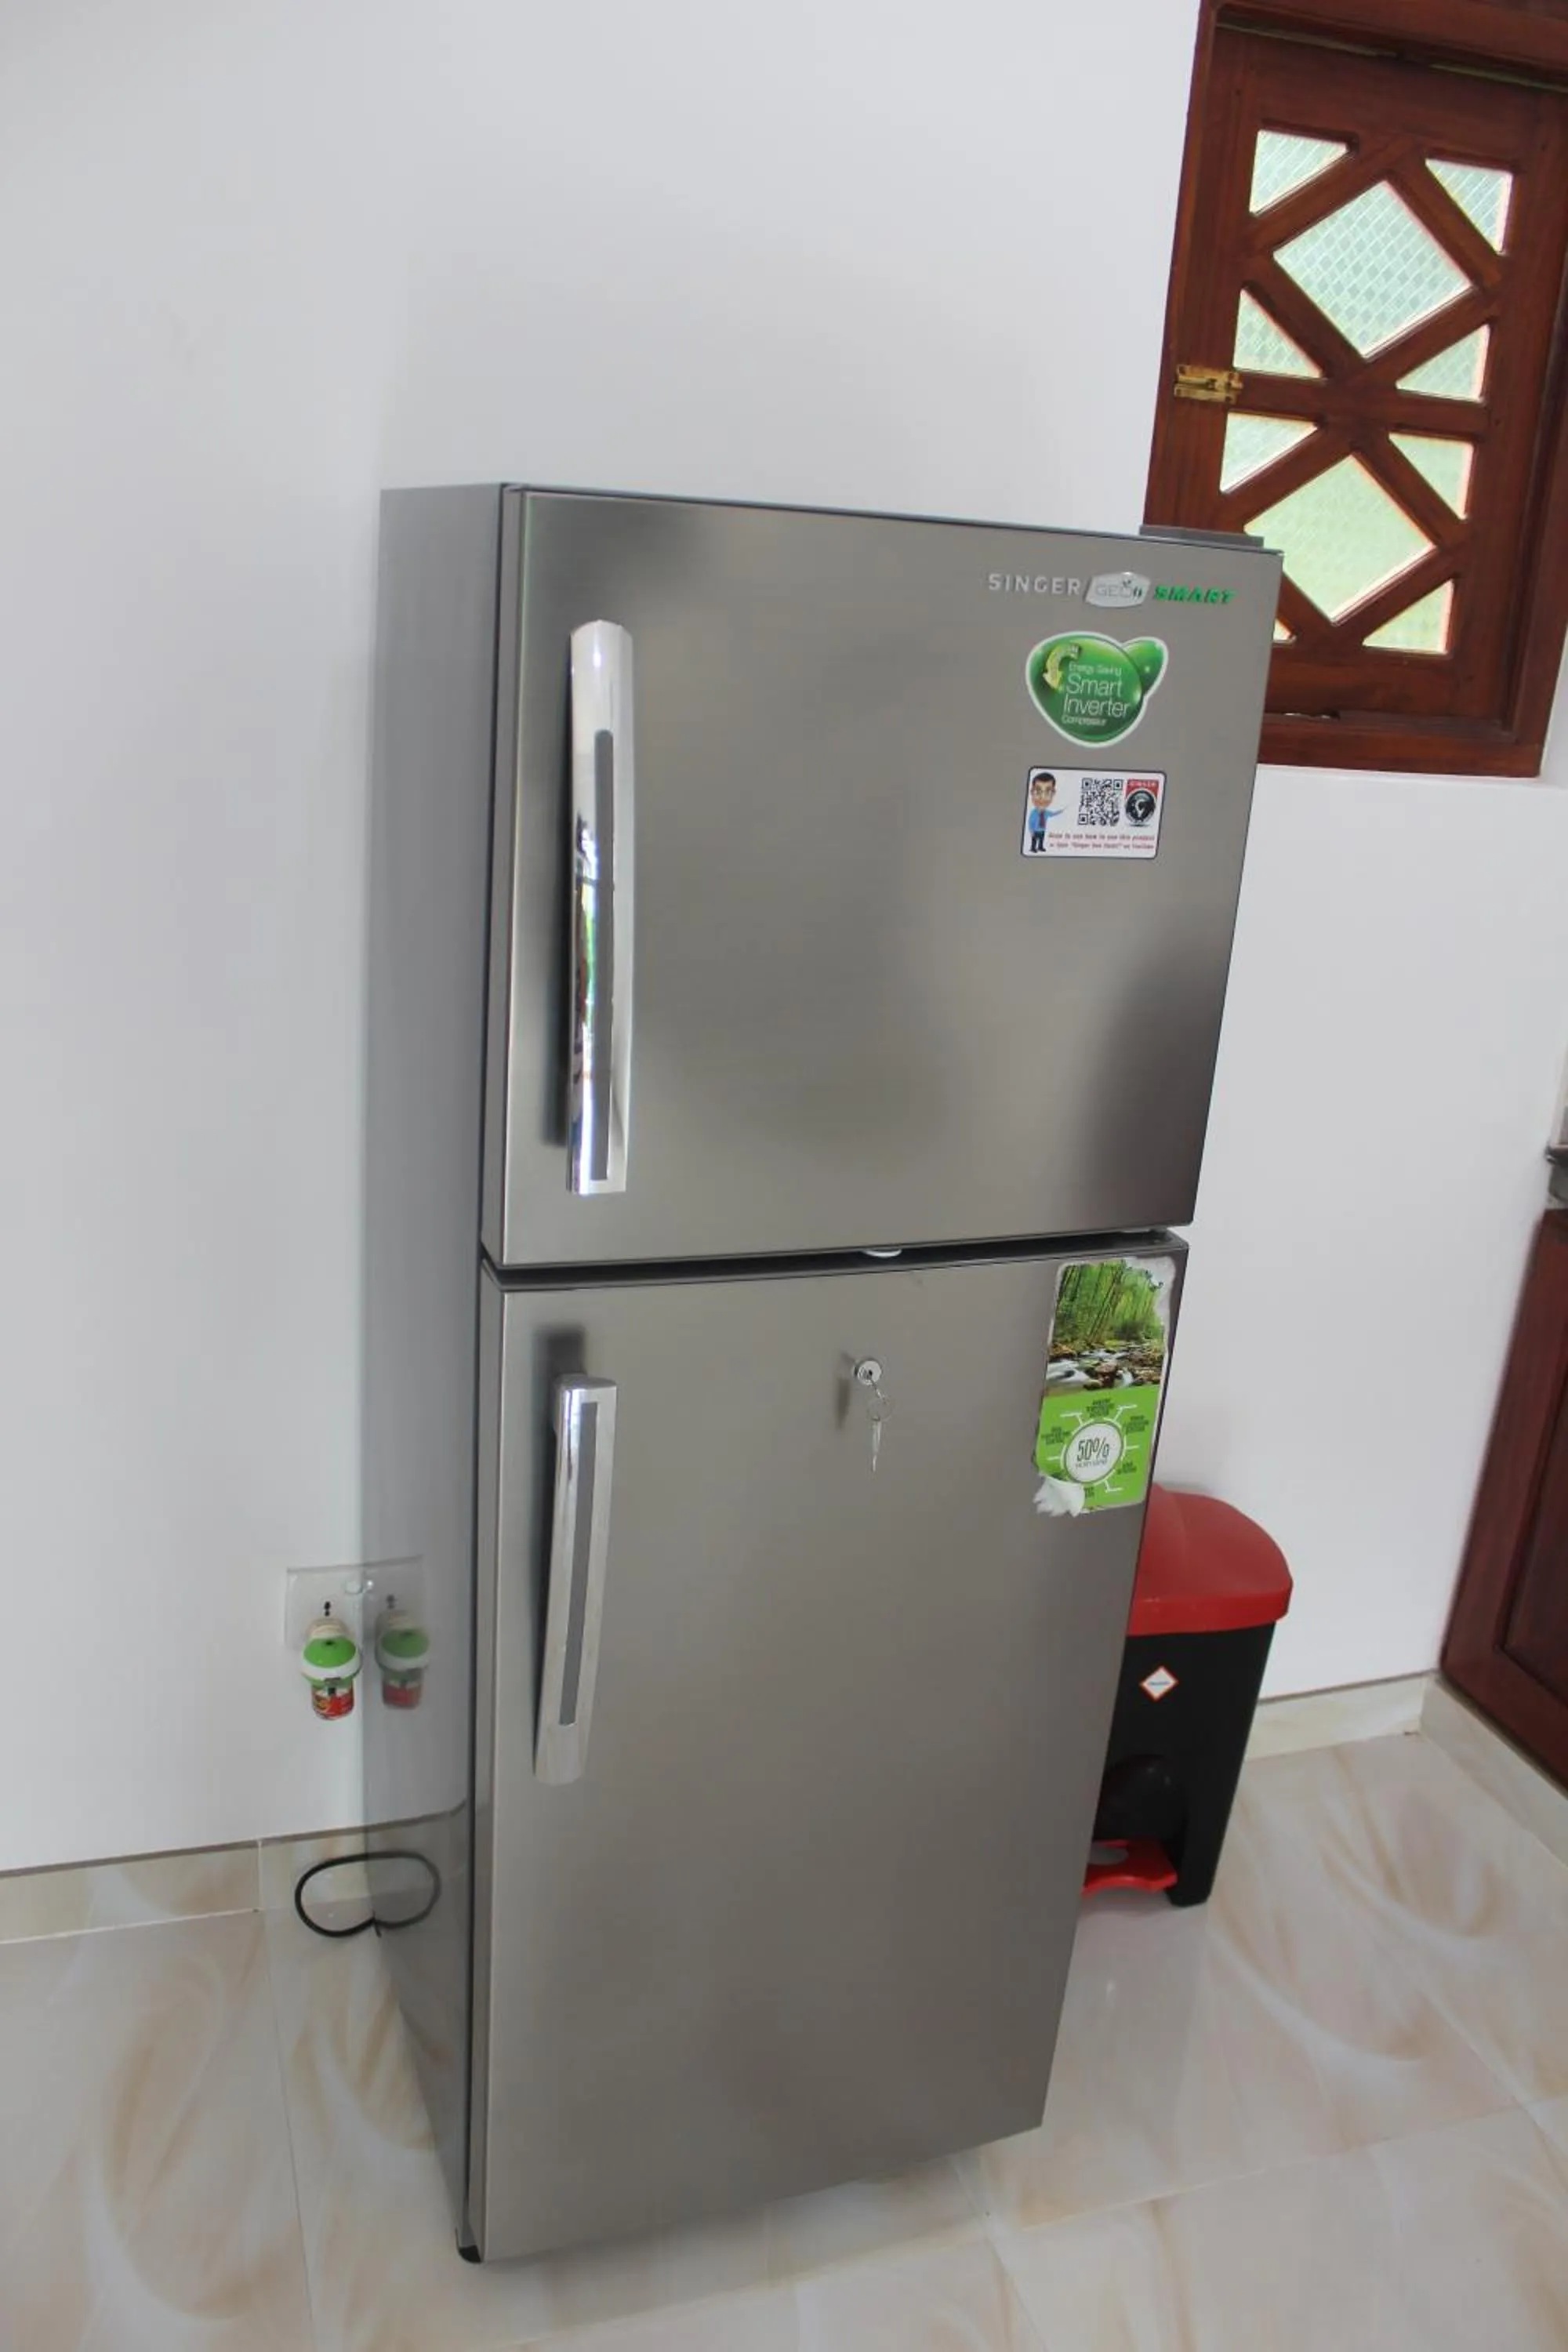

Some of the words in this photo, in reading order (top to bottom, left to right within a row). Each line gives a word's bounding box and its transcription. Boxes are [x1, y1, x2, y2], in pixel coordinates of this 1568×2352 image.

[989, 573, 1081, 596] SINGER
[1153, 585, 1237, 604] SMART
[1066, 673, 1123, 697] Smart
[1063, 694, 1131, 717] Inverter
[1077, 1436, 1109, 1461] 50%
